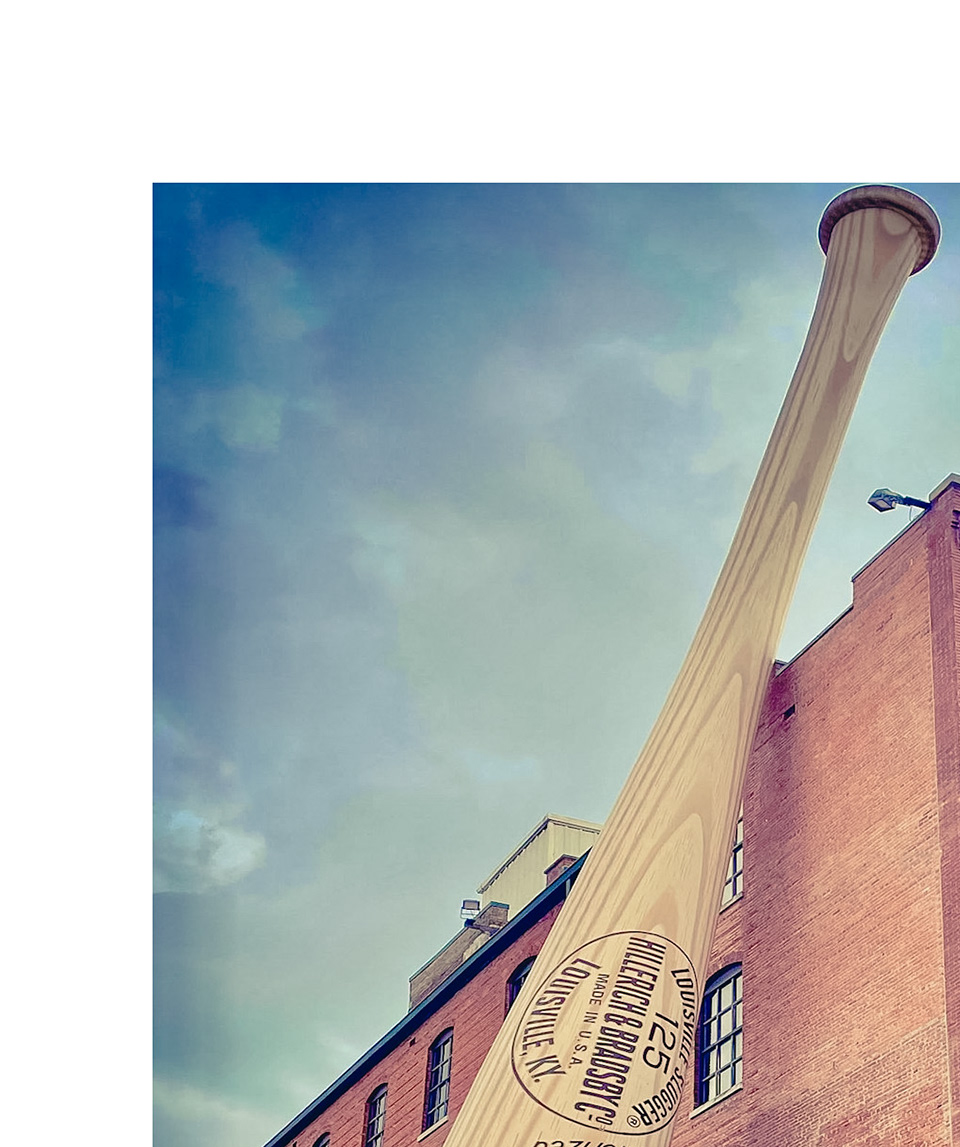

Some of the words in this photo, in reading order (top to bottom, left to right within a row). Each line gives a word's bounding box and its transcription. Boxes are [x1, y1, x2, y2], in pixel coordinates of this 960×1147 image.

[588, 972, 610, 1006] MADE
[607, 936, 667, 1017] HILLERICH
[582, 1011, 599, 1024] IN
[603, 1012, 643, 1030] &
[671, 967, 696, 1065] LOUISVILLE
[568, 1030, 592, 1069] U.S.A.
[642, 1011, 680, 1075] 125
[525, 1054, 567, 1083] KY.
[580, 1025, 640, 1108] BRADSBY
